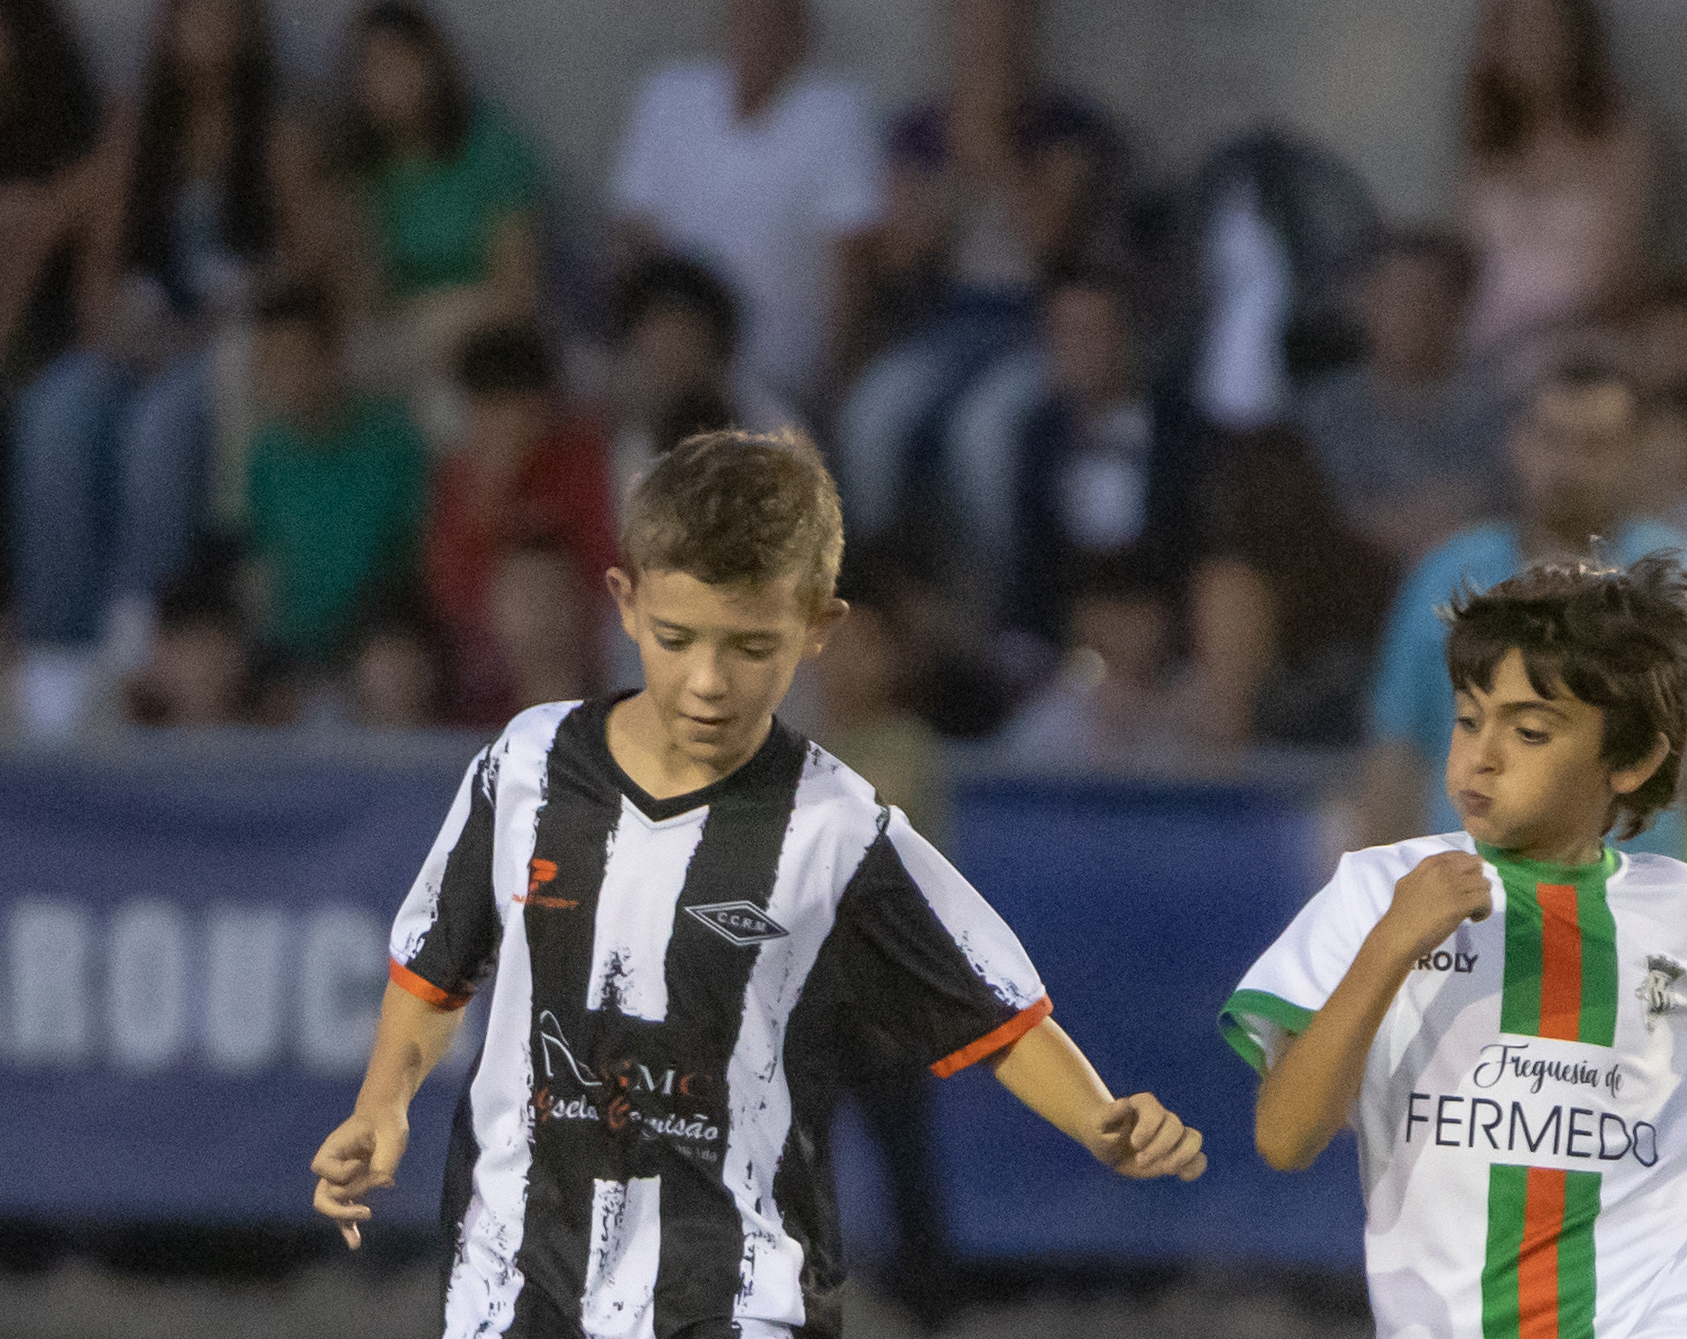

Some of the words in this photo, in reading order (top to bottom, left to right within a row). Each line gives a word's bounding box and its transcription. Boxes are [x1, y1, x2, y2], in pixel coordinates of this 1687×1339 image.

[1418, 950, 1479, 974] ROLY
[1473, 1043, 1600, 1094] Freguesia
[1405, 1091, 1659, 1168] FERMEDO
